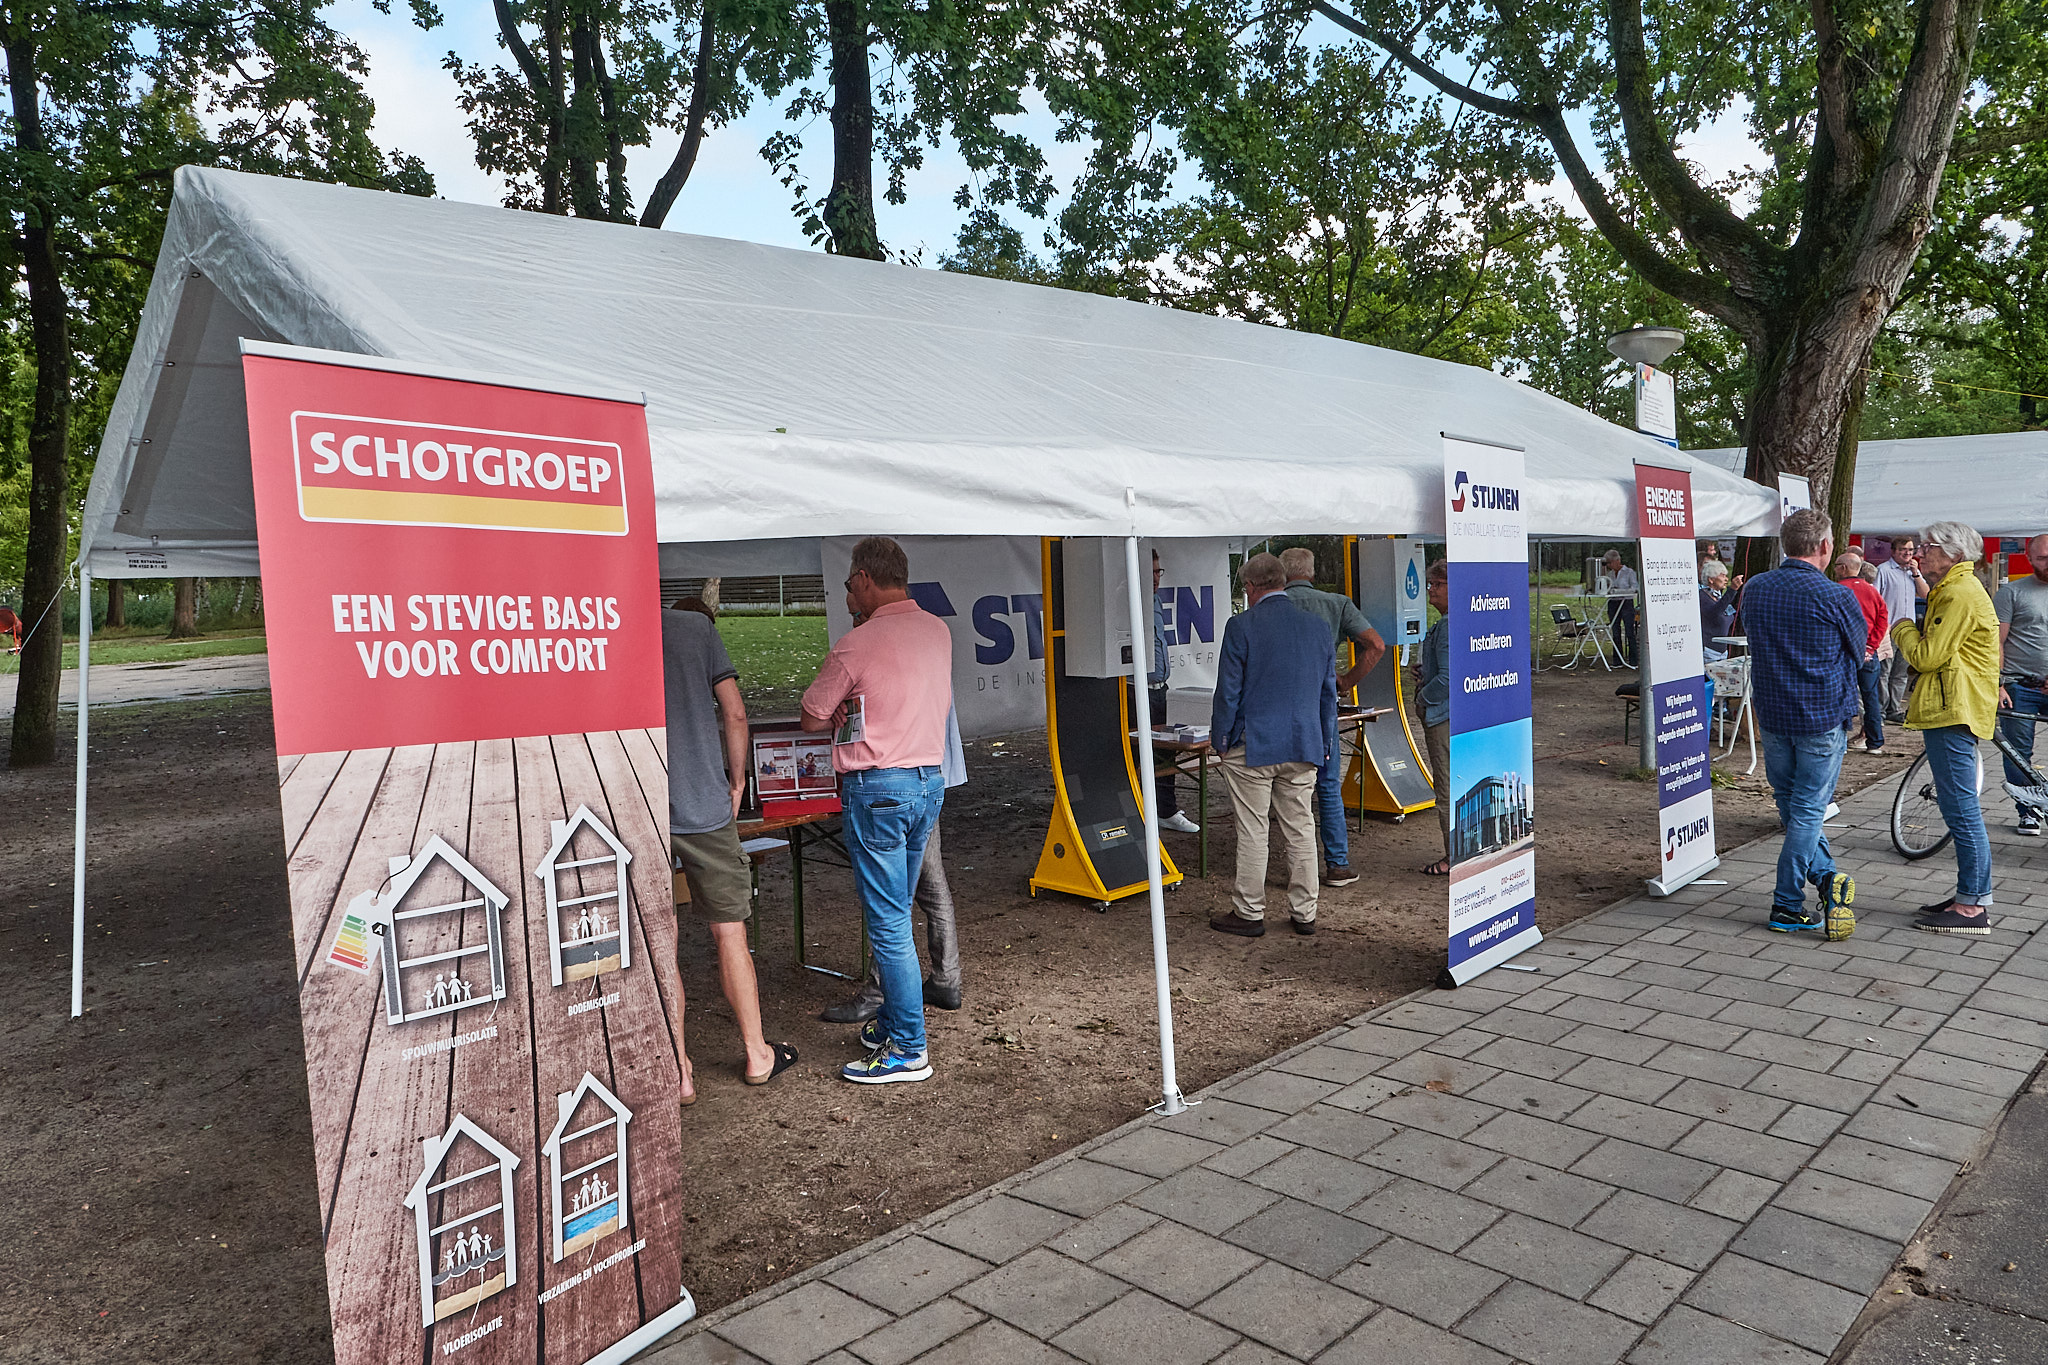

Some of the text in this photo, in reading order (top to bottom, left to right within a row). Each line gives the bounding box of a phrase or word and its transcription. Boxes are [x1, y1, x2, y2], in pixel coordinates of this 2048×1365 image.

[310, 432, 612, 493] SCHOTGROEP
[1472, 485, 1519, 511] STIJNEN
[1645, 486, 1684, 509] ENERGIE
[1646, 508, 1686, 527] TRANSITIE
[1406, 575, 1418, 595] H2
[331, 594, 621, 633] EEN STEVIGE BASIS
[1470, 593, 1511, 612] Adviseren
[1470, 633, 1513, 653] Installeren
[355, 637, 608, 679] VOOR COMFORT
[977, 675, 1000, 691] DE
[1463, 669, 1519, 694] Onderhouden
[1677, 815, 1710, 848] STIJNEN
[374, 924, 383, 935] A
[1468, 911, 1519, 948] www.stijnen.nl
[567, 991, 621, 1017] BODEMISOLATIE
[401, 1025, 498, 1061] SPOUWMUURISOLATIE
[537, 1237, 646, 1305] VERZAKKING EN VOCHTPROBLEEM
[442, 1315, 503, 1356] VLOERISOLATIE
